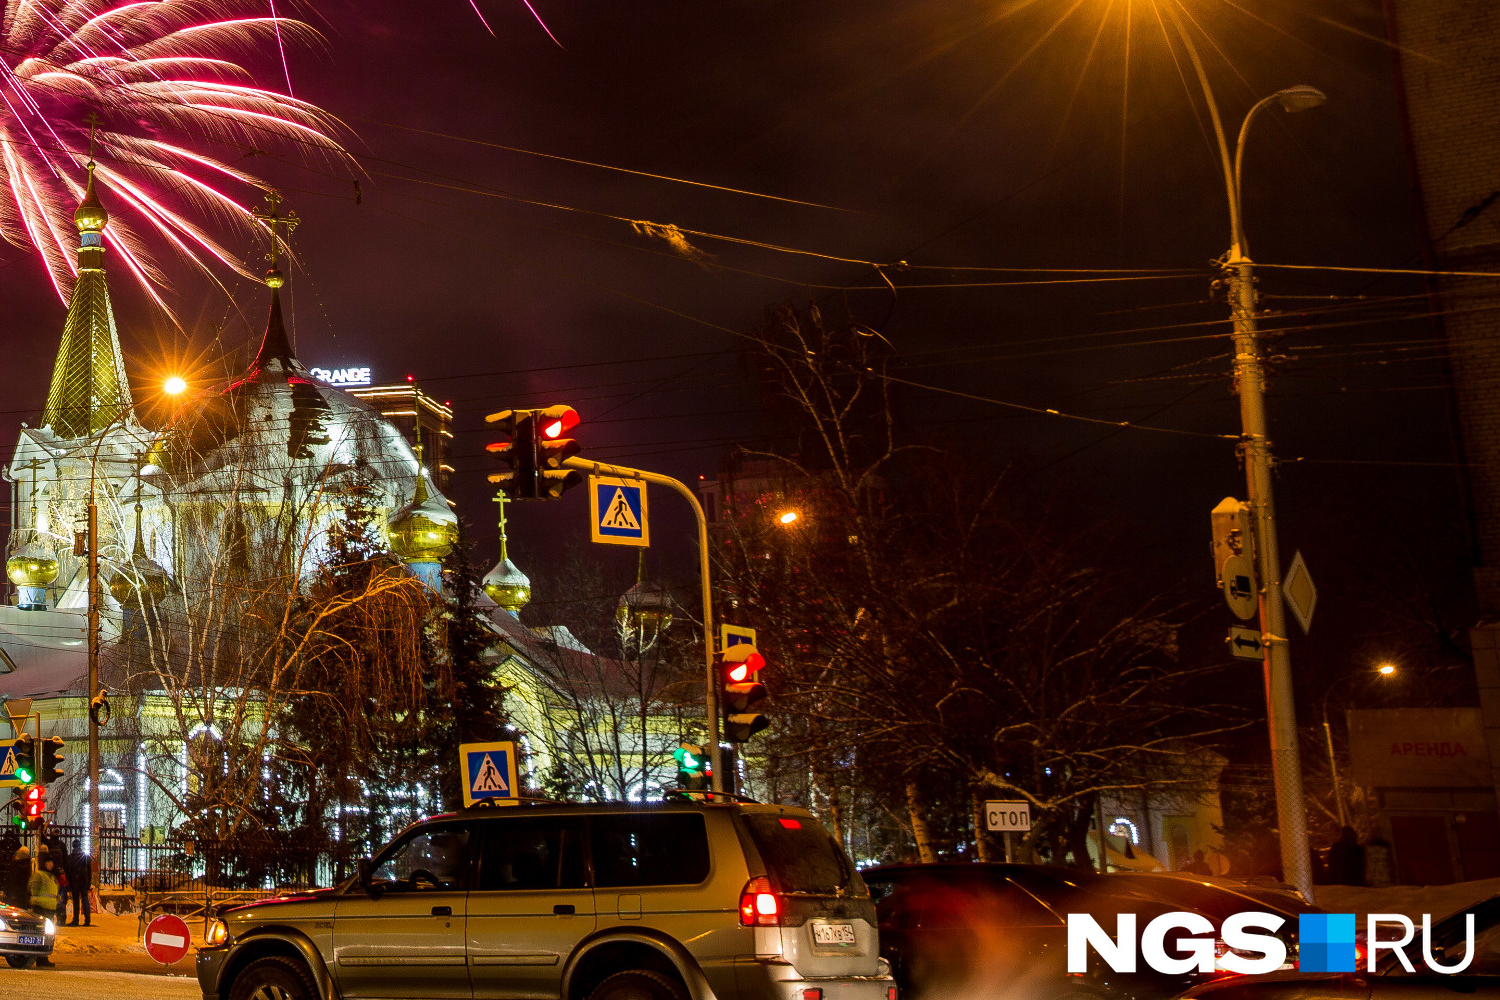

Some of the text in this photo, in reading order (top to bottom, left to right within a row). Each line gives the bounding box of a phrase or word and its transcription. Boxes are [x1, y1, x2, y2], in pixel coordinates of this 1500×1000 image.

[310, 367, 370, 382] GRANDE
[1389, 741, 1467, 757] АРЕНДА
[989, 811, 1028, 826] СТОП
